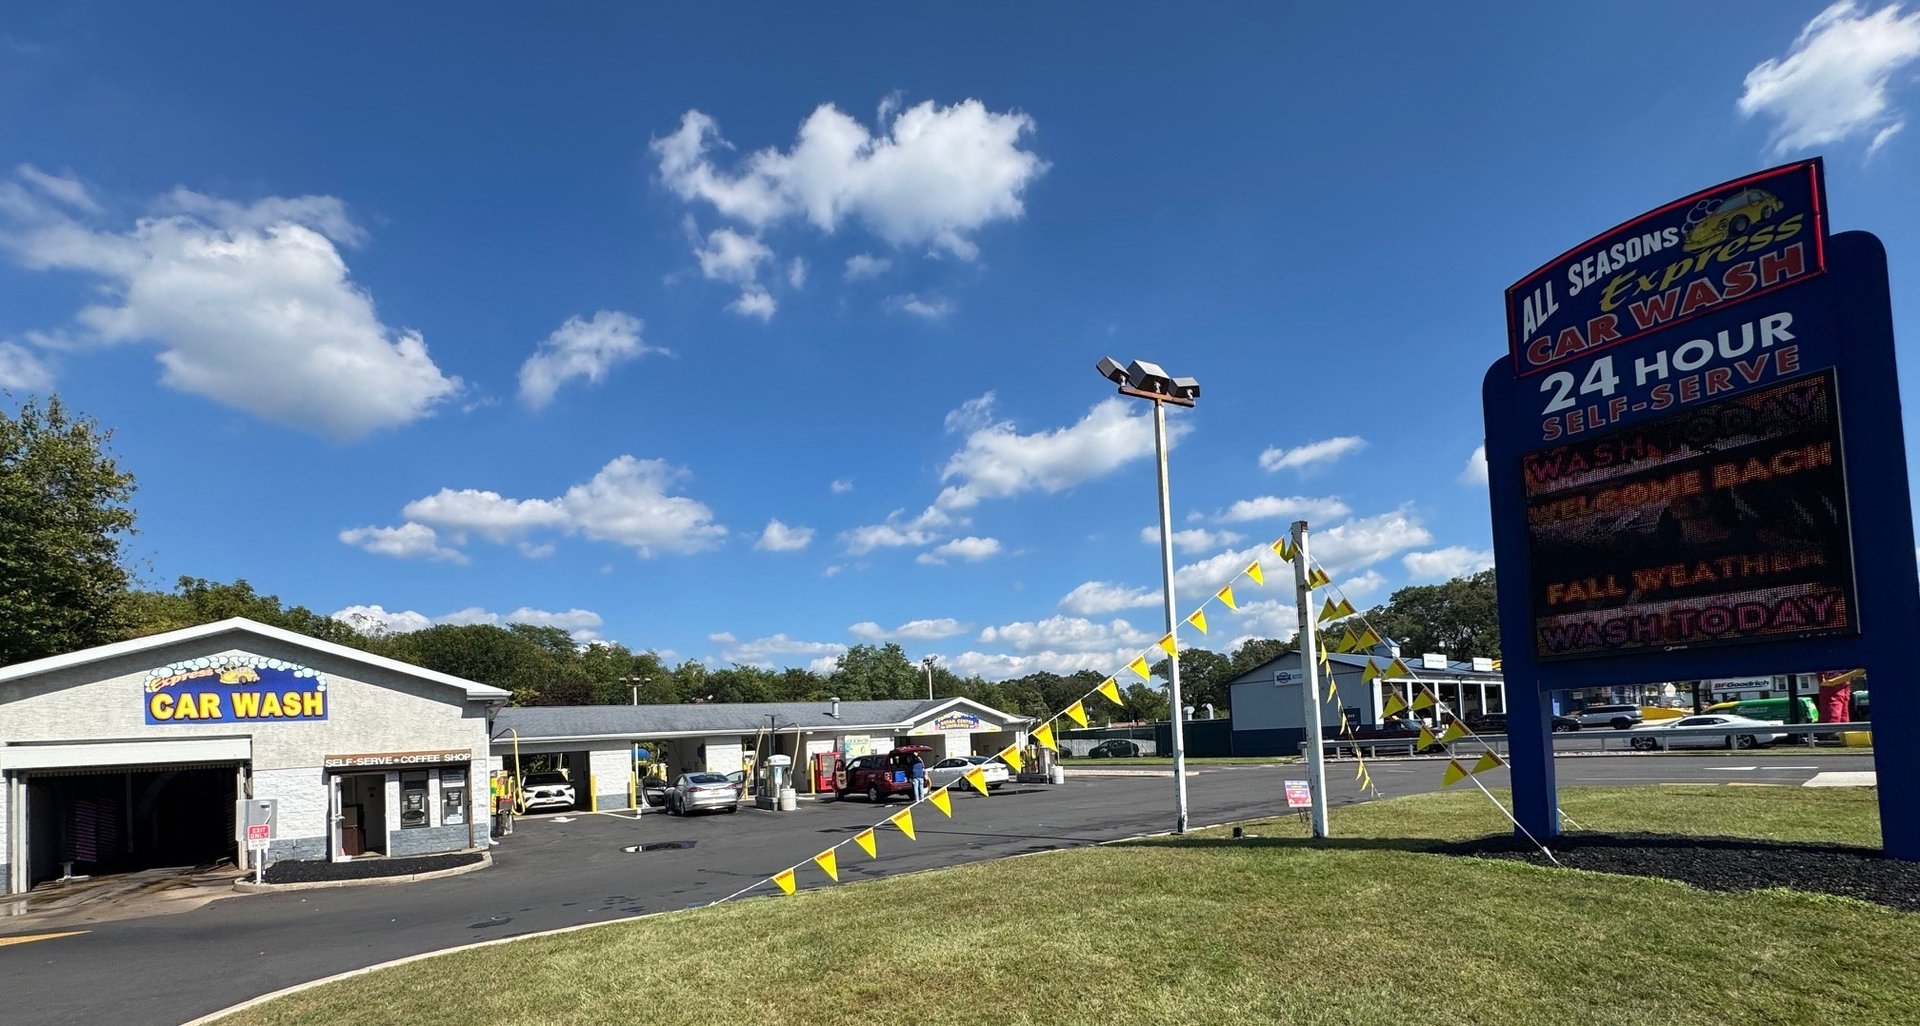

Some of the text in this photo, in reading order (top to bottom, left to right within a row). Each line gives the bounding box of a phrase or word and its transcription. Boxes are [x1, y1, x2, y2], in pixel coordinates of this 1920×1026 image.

[1522, 226, 1680, 344] ALL SEASONS
[1599, 213, 1805, 313] Express
[1526, 241, 1806, 367] CAR WASH
[1540, 311, 1797, 416] 24 HOUR
[1542, 344, 1801, 441] SELF-SERVE
[1530, 435, 1651, 483] WASH
[1529, 470, 1704, 523] WELCOME
[1546, 574, 1627, 606] FALL
[1632, 554, 1824, 592] WEATHER
[1541, 596, 1836, 653] WASH TODAY
[150, 691, 325, 720] CAR WASH
[1714, 680, 1769, 689] BFGoodrich
[400, 754, 440, 764] COFFEE
[444, 753, 471, 762] SHOP
